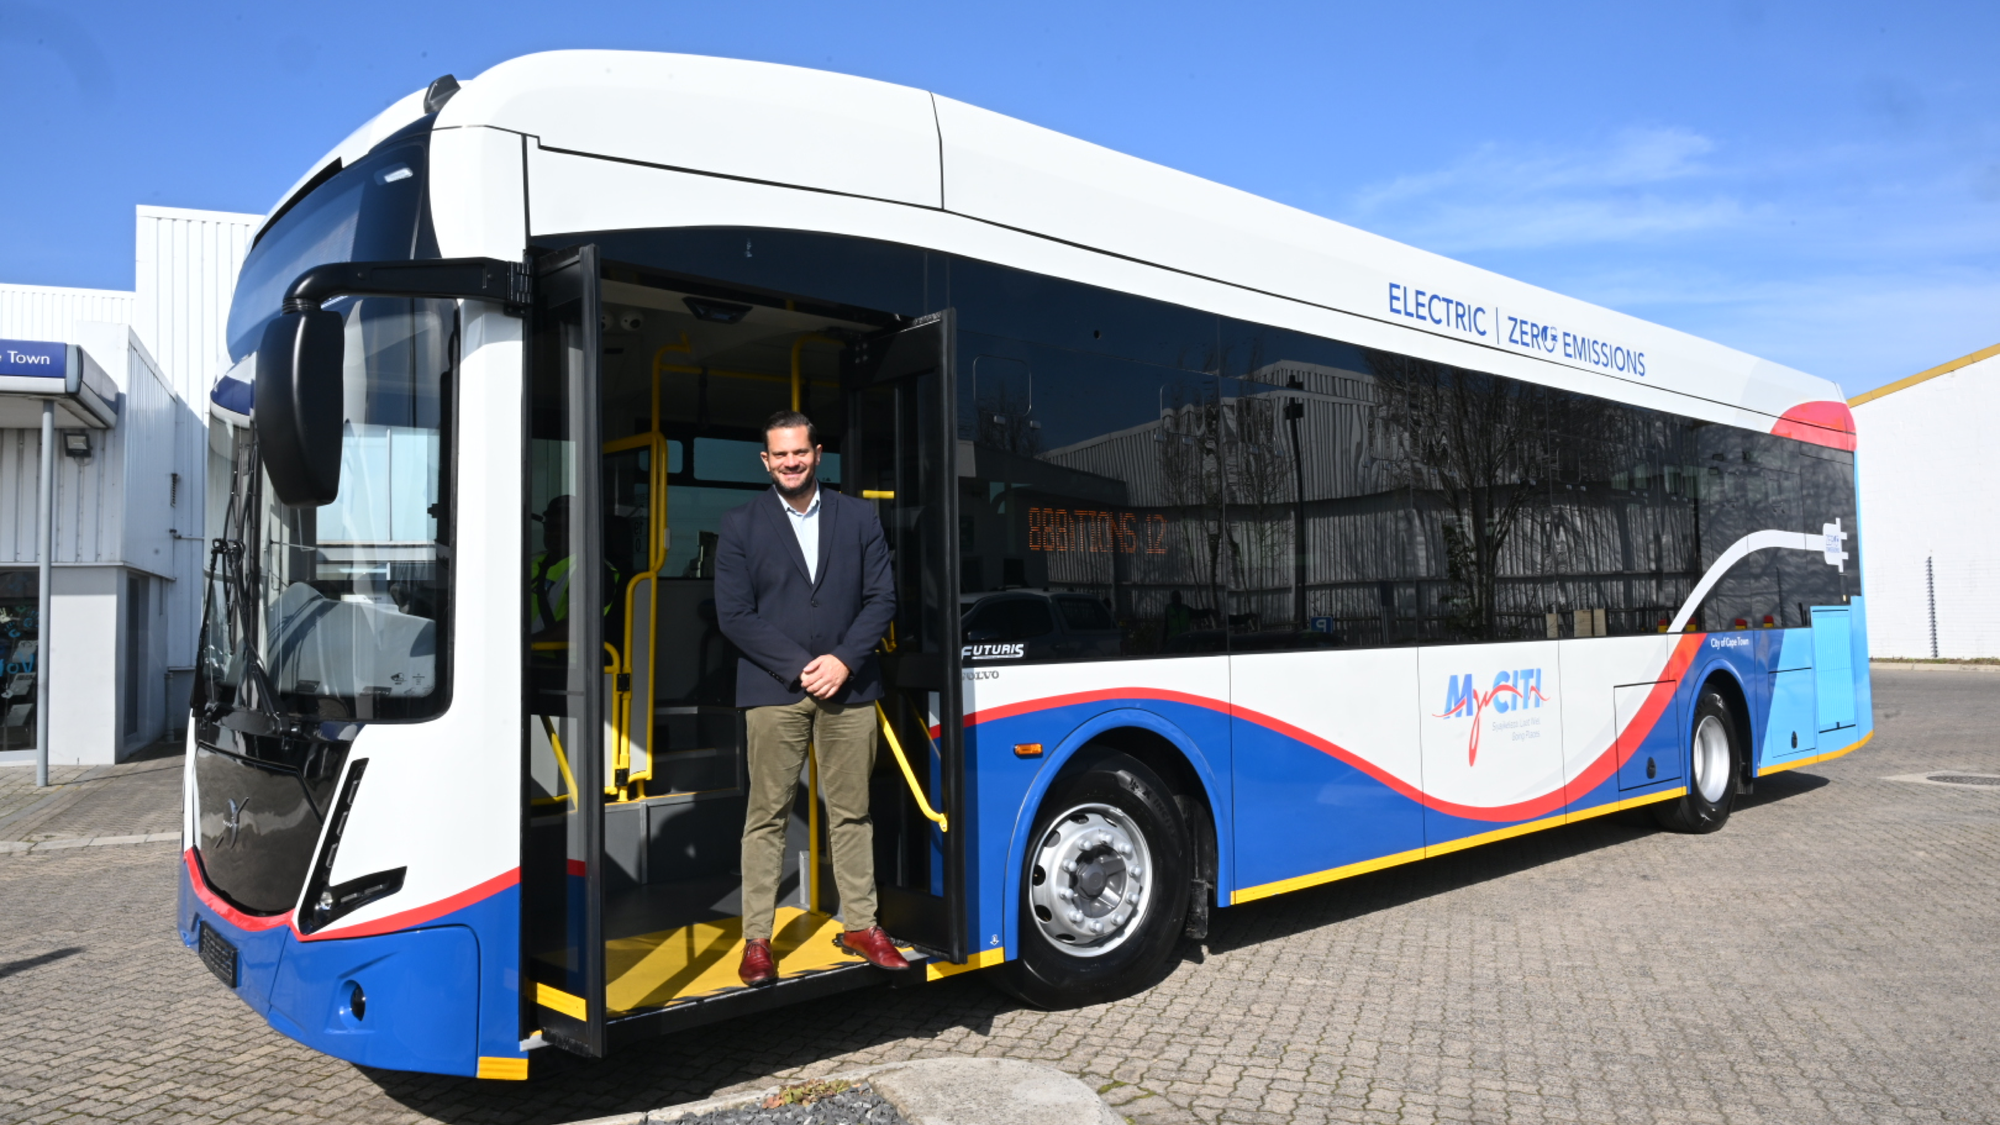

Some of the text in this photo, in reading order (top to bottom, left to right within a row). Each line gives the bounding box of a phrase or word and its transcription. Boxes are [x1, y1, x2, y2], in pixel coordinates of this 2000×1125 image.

[1389, 282, 1646, 377] ELECTRIC ZERO EMISSIONS
[7, 350, 50, 365] Town
[1710, 637, 1720, 650] City
[1725, 636, 1737, 649] Cape
[1737, 636, 1749, 646] Town
[961, 643, 1024, 660] FUTURIS
